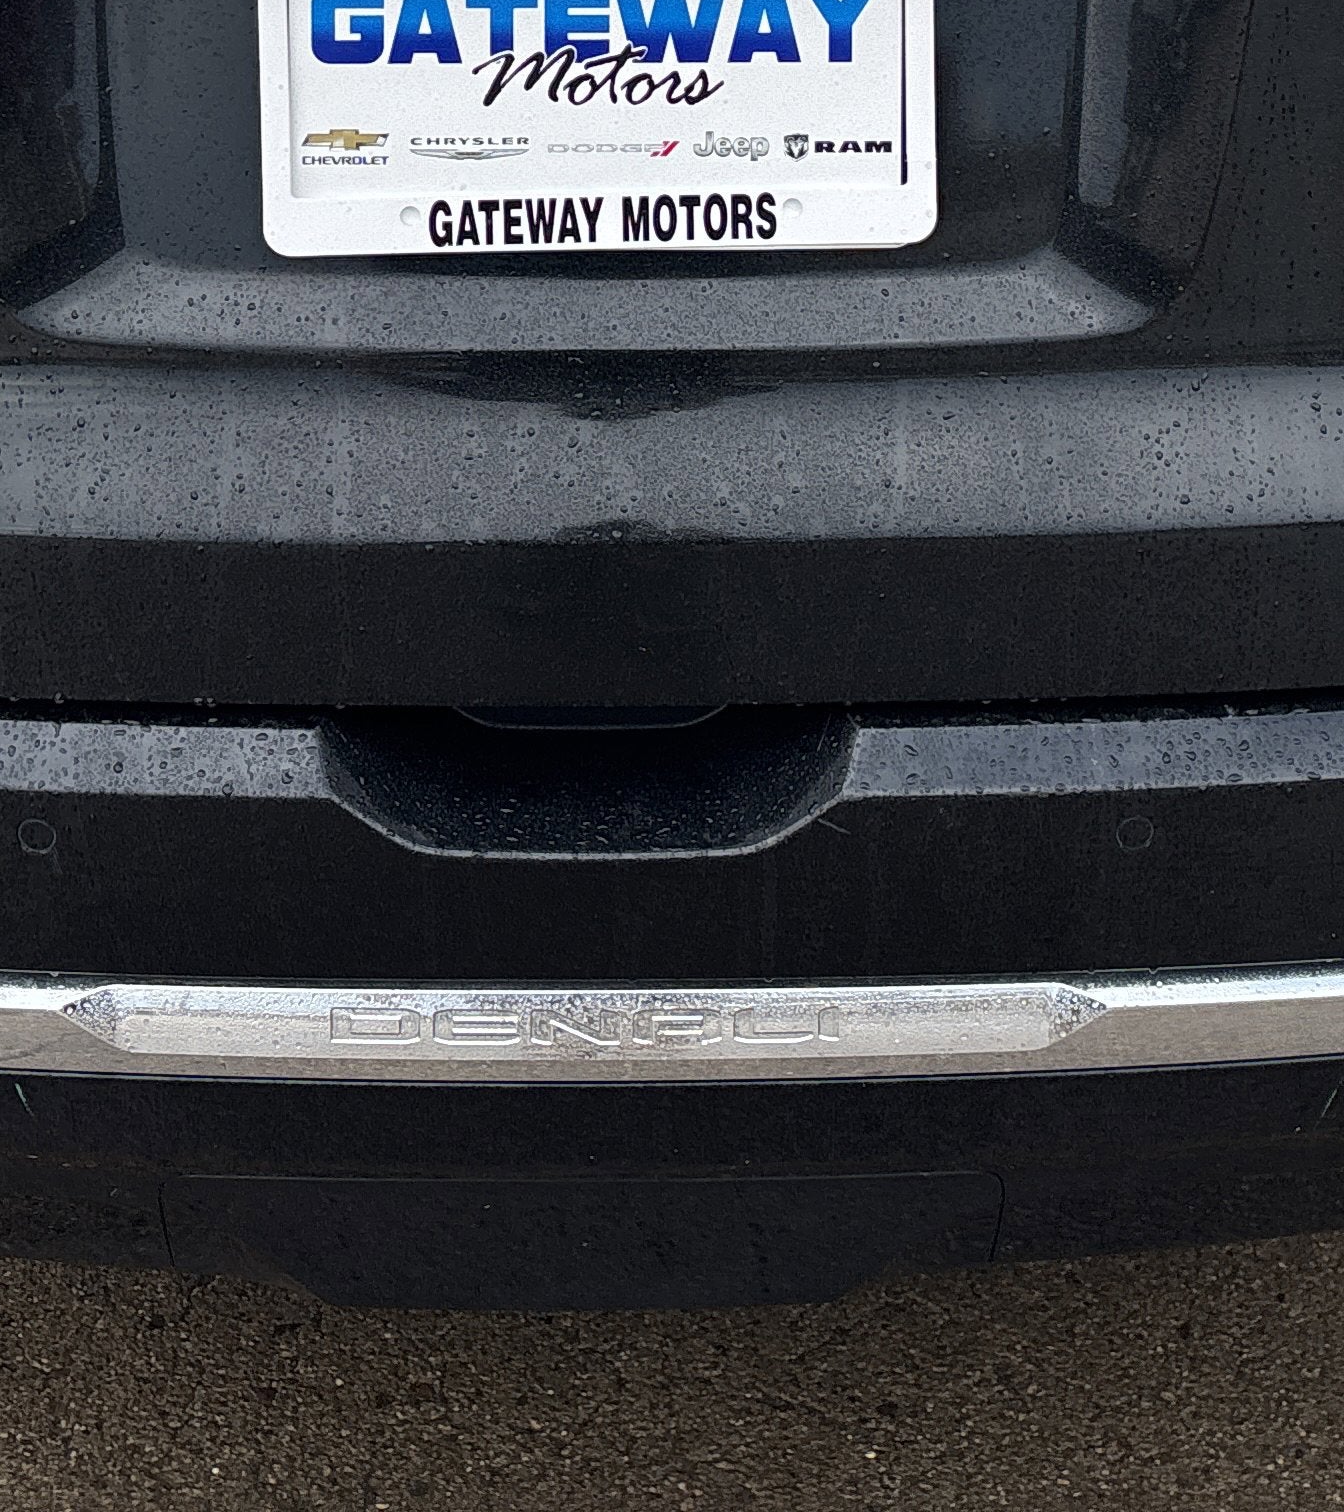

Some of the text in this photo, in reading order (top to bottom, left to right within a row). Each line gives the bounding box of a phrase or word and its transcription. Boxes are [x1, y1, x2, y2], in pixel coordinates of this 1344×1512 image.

[471, 43, 725, 108] Motors
[410, 136, 530, 146] CHRYSLER
[547, 143, 665, 153] DODGE
[692, 131, 770, 162] Jeep
[814, 140, 893, 154] RAM
[301, 155, 390, 166] CHEVROLET
[428, 193, 777, 246] GATEWAY MOTORS
[330, 1004, 840, 1047] DENALI
